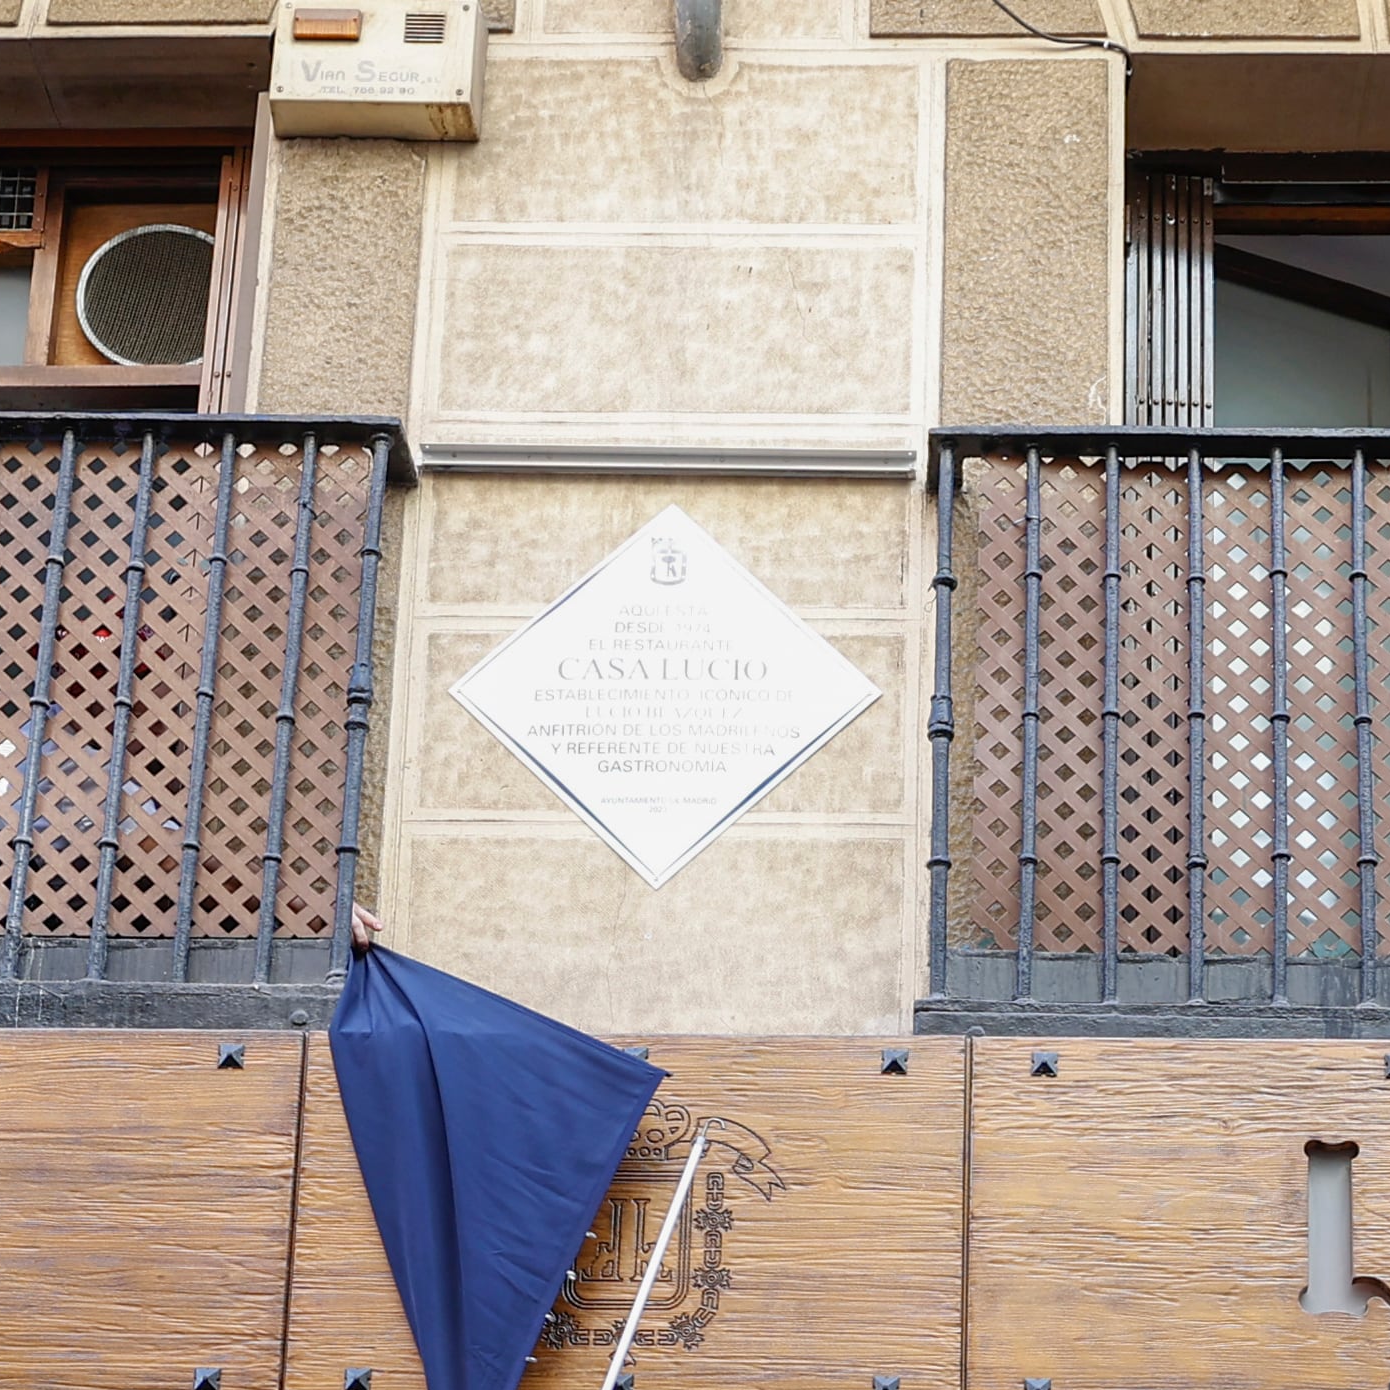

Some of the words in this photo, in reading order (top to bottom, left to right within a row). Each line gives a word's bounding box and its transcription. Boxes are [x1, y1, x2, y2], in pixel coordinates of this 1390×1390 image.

[588, 639, 606, 651] EL
[613, 639, 734, 651] RESTAURANTE
[557, 657, 650, 681] CASA
[661, 657, 768, 681] LUCIO
[534, 688, 690, 702] ESTABLECIMIENTO
[623, 724, 643, 737] DE
[649, 724, 683, 737] LOS
[551, 743, 561, 755] Y
[566, 742, 662, 755] REFERENTE
[667, 743, 688, 755] DE
[695, 743, 776, 756] NUESTRA
